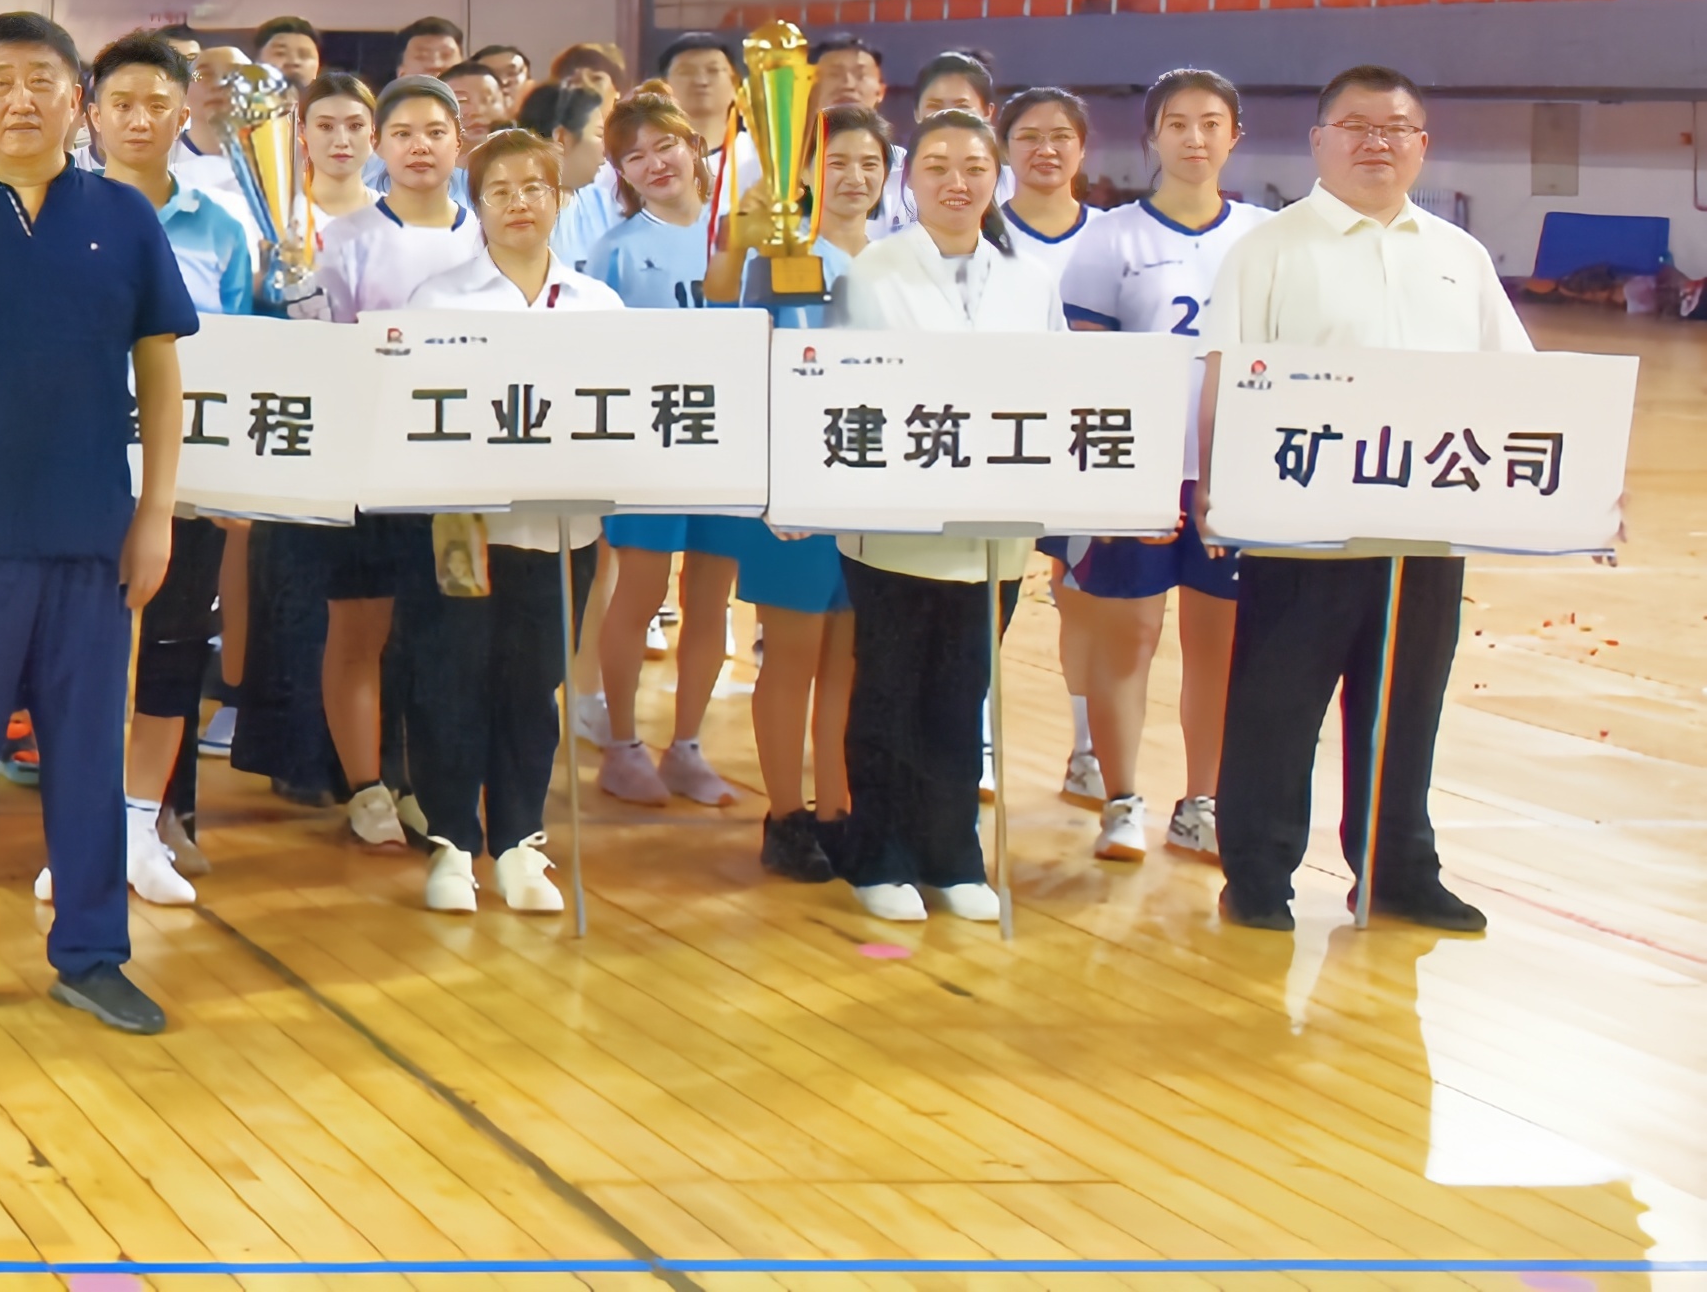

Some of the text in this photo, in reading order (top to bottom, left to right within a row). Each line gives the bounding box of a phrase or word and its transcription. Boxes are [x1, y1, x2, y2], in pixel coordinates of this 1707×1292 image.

[407, 383, 719, 448] 工业工程
[823, 404, 1136, 472] 建筑工程
[1274, 424, 1565, 496] 矿山公司
